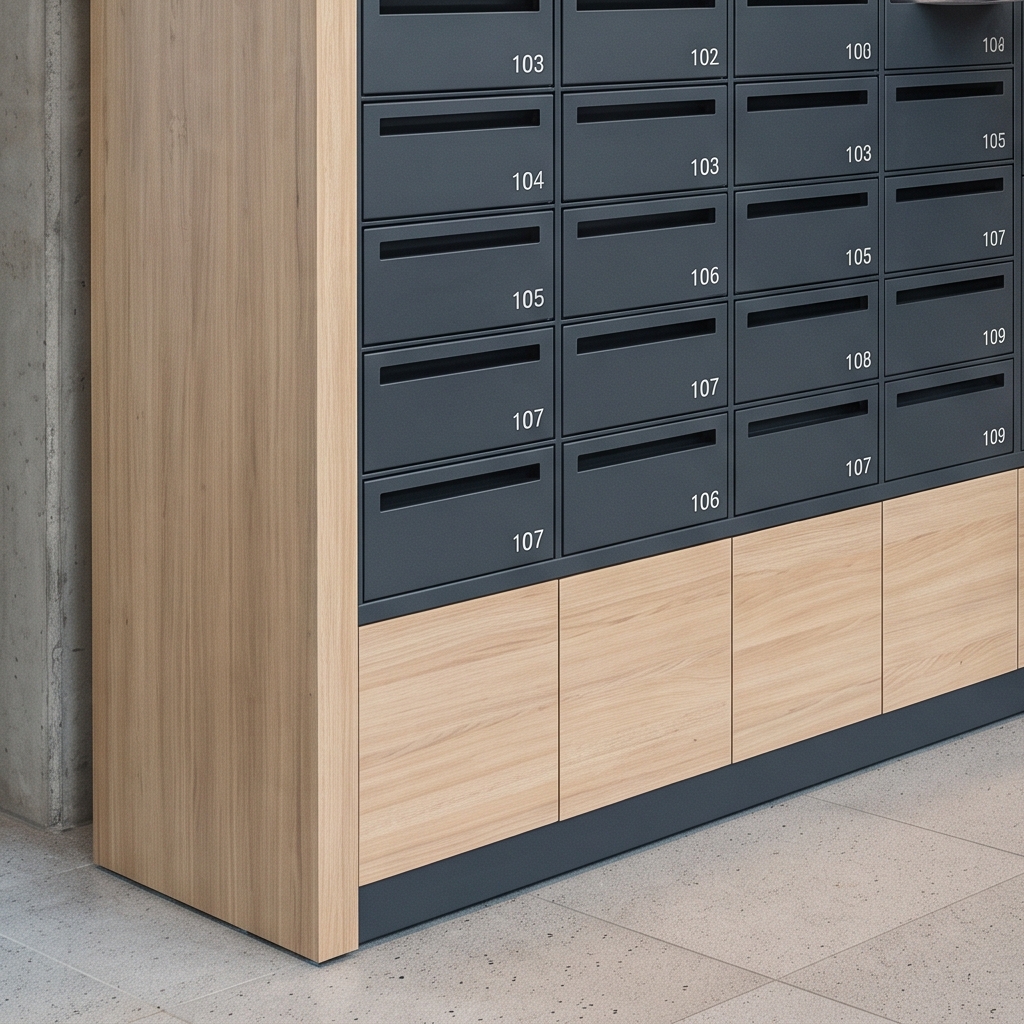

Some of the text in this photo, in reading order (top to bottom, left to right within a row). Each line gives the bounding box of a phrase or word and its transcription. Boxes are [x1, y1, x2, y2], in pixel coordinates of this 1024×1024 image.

[512, 53, 544, 74] 103
[691, 47, 720, 66] 102
[982, 132, 1006, 150] 105
[845, 144, 872, 163] 103
[690, 156, 720, 177] 103
[512, 170, 545, 191] 104
[982, 229, 1006, 247] 107
[845, 246, 872, 266] 105
[690, 266, 720, 287] 106
[512, 287, 545, 310] 105
[982, 327, 1006, 346] 109
[845, 350, 872, 371] 108
[691, 377, 720, 399] 107
[512, 407, 544, 431] 107
[982, 427, 1006, 447] 109
[845, 456, 872, 477] 107
[691, 490, 720, 513] 106
[512, 528, 544, 553] 107
